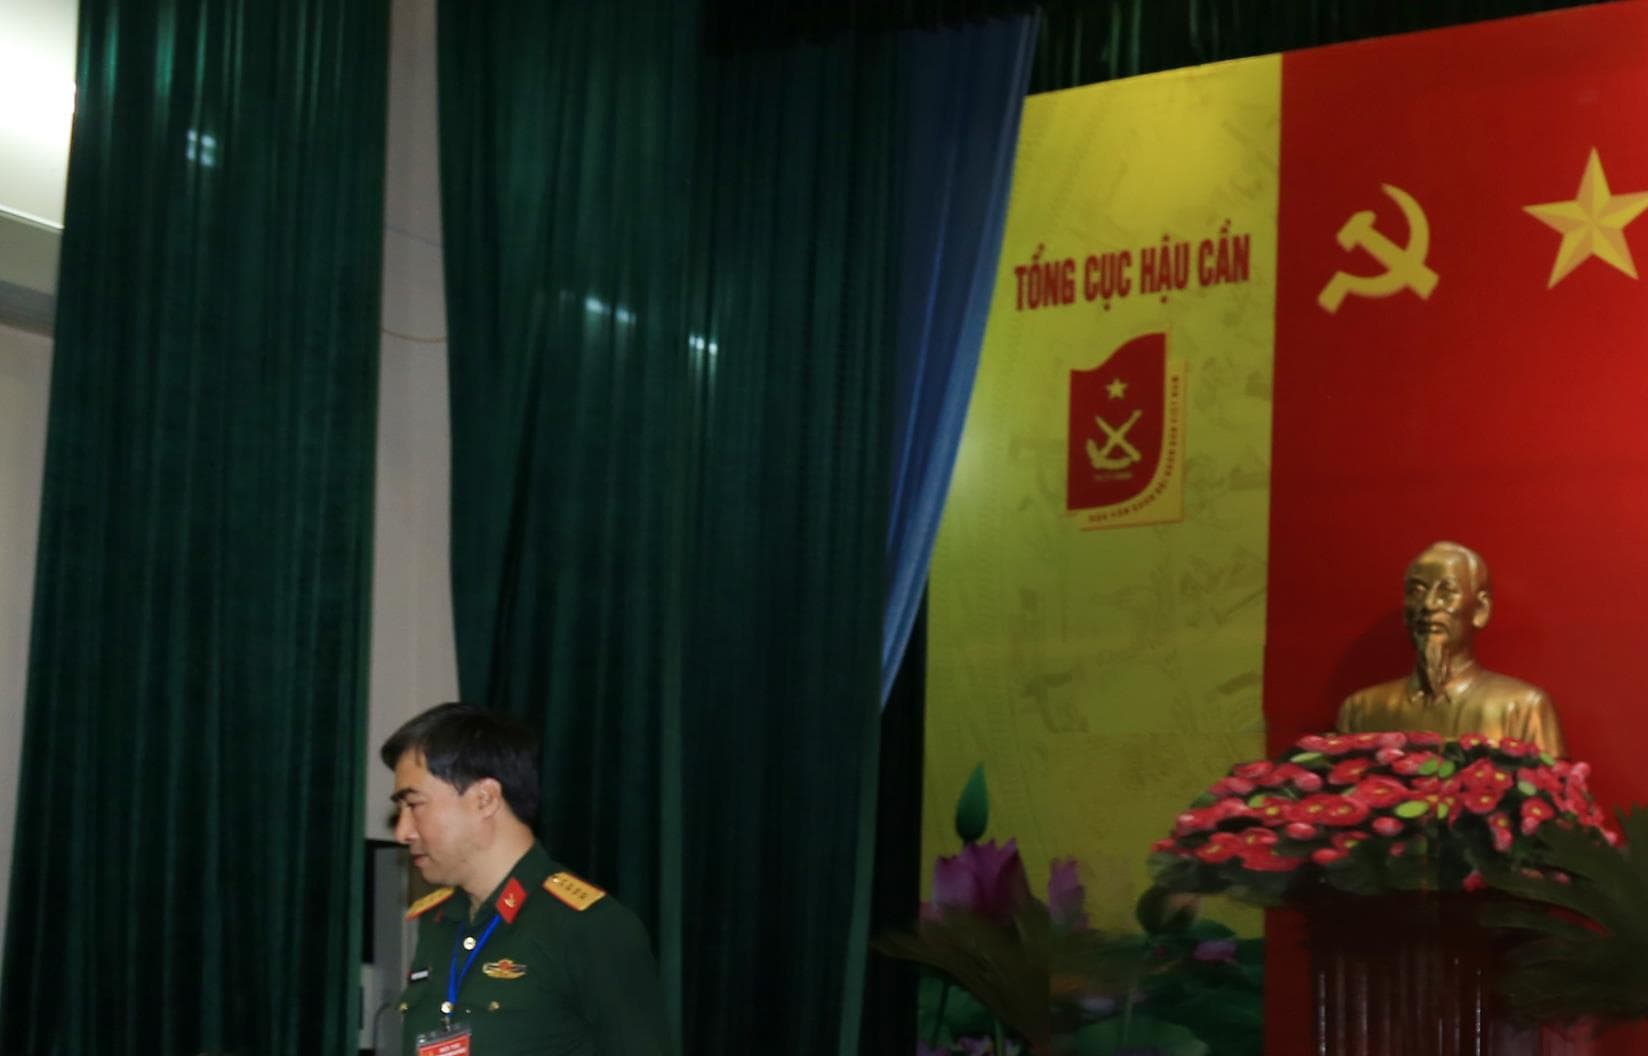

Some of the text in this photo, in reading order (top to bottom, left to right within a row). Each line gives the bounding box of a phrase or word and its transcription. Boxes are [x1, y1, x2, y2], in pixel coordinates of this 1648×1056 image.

[1014, 243, 1076, 311] TỔNG
[1084, 250, 1132, 311] CỤC
[1140, 233, 1190, 304] HẬU
